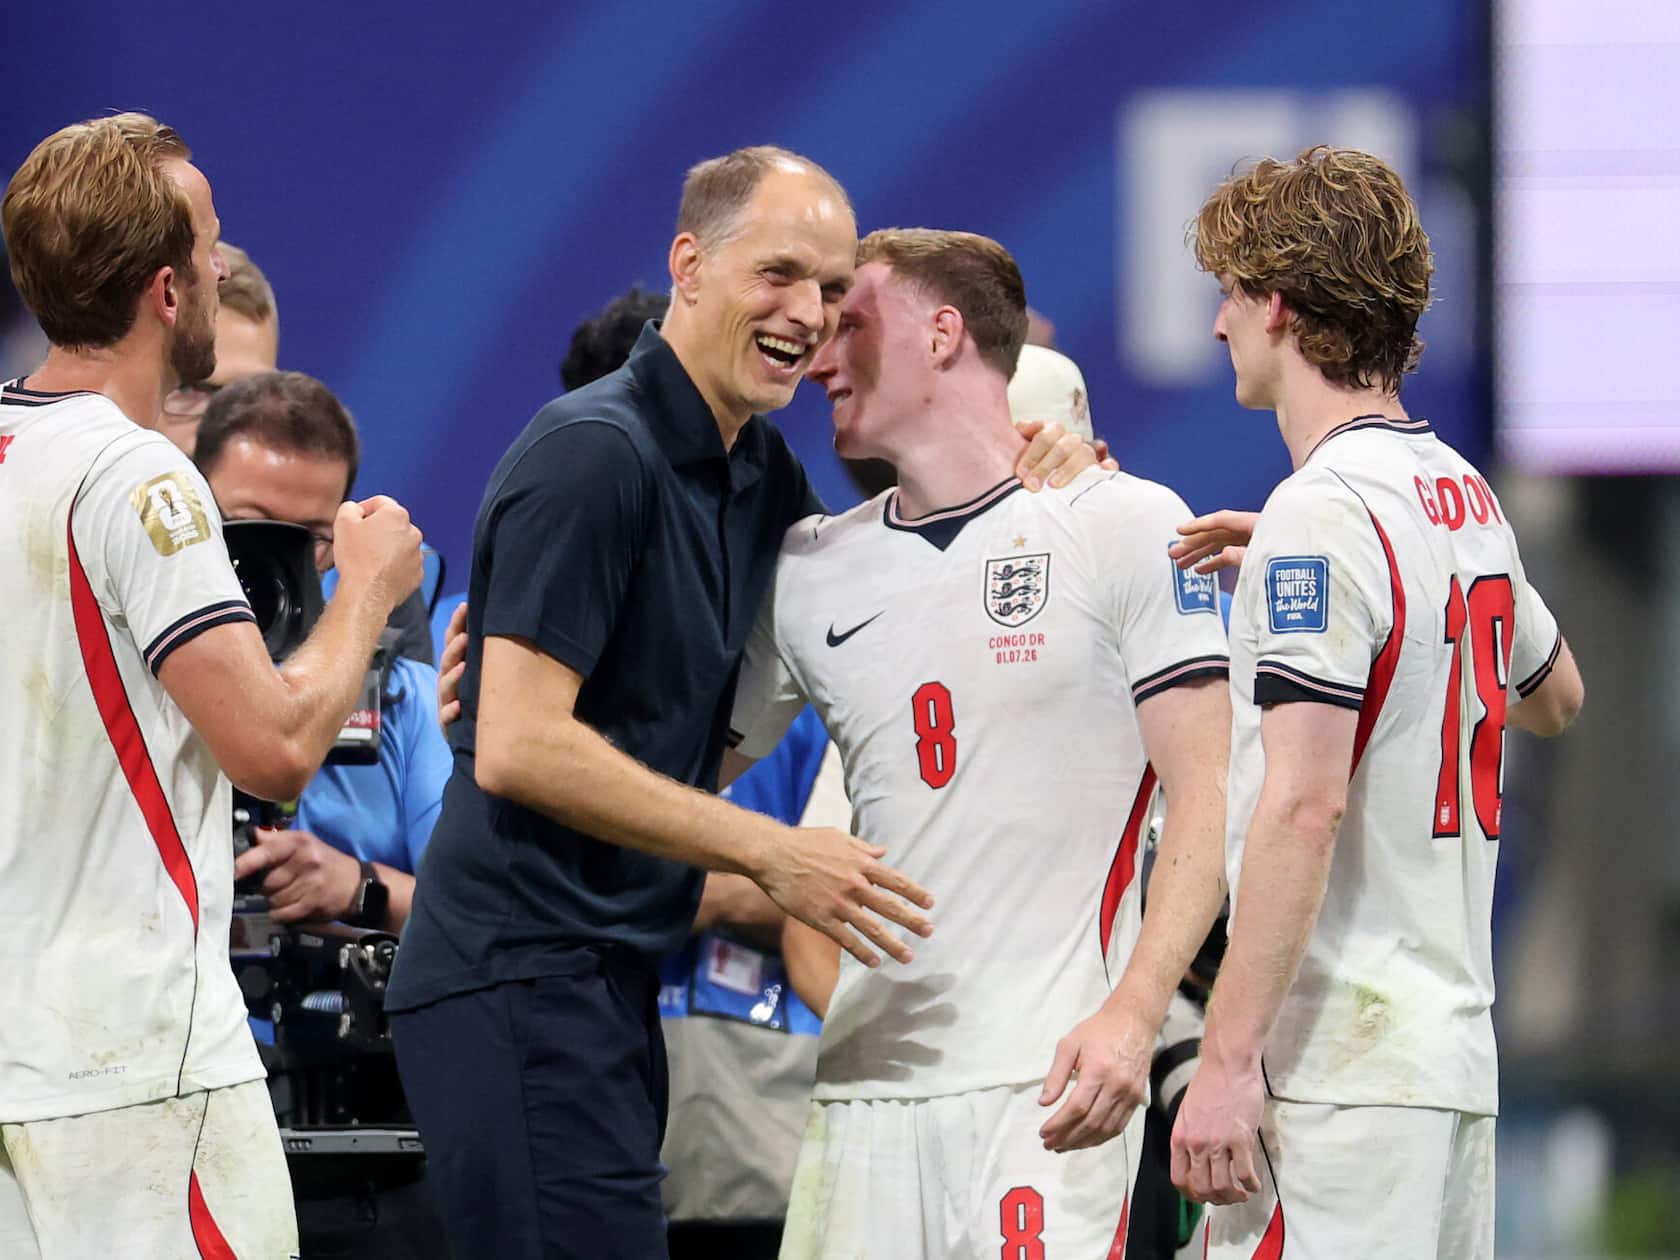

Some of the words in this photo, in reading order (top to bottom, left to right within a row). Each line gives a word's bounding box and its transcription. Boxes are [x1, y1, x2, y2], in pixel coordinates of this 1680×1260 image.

[1275, 568, 1317, 581] FOOTBALL
[1276, 580, 1317, 597] UNITES
[1275, 597, 1290, 612] the
[1290, 596, 1320, 612] World
[989, 634, 1026, 649] CONGO
[1029, 633, 1045, 646] DR
[996, 649, 1037, 664] 01.07.26
[1432, 573, 1515, 840] 18
[911, 681, 957, 790] 8
[1000, 1185, 1045, 1260] 8
